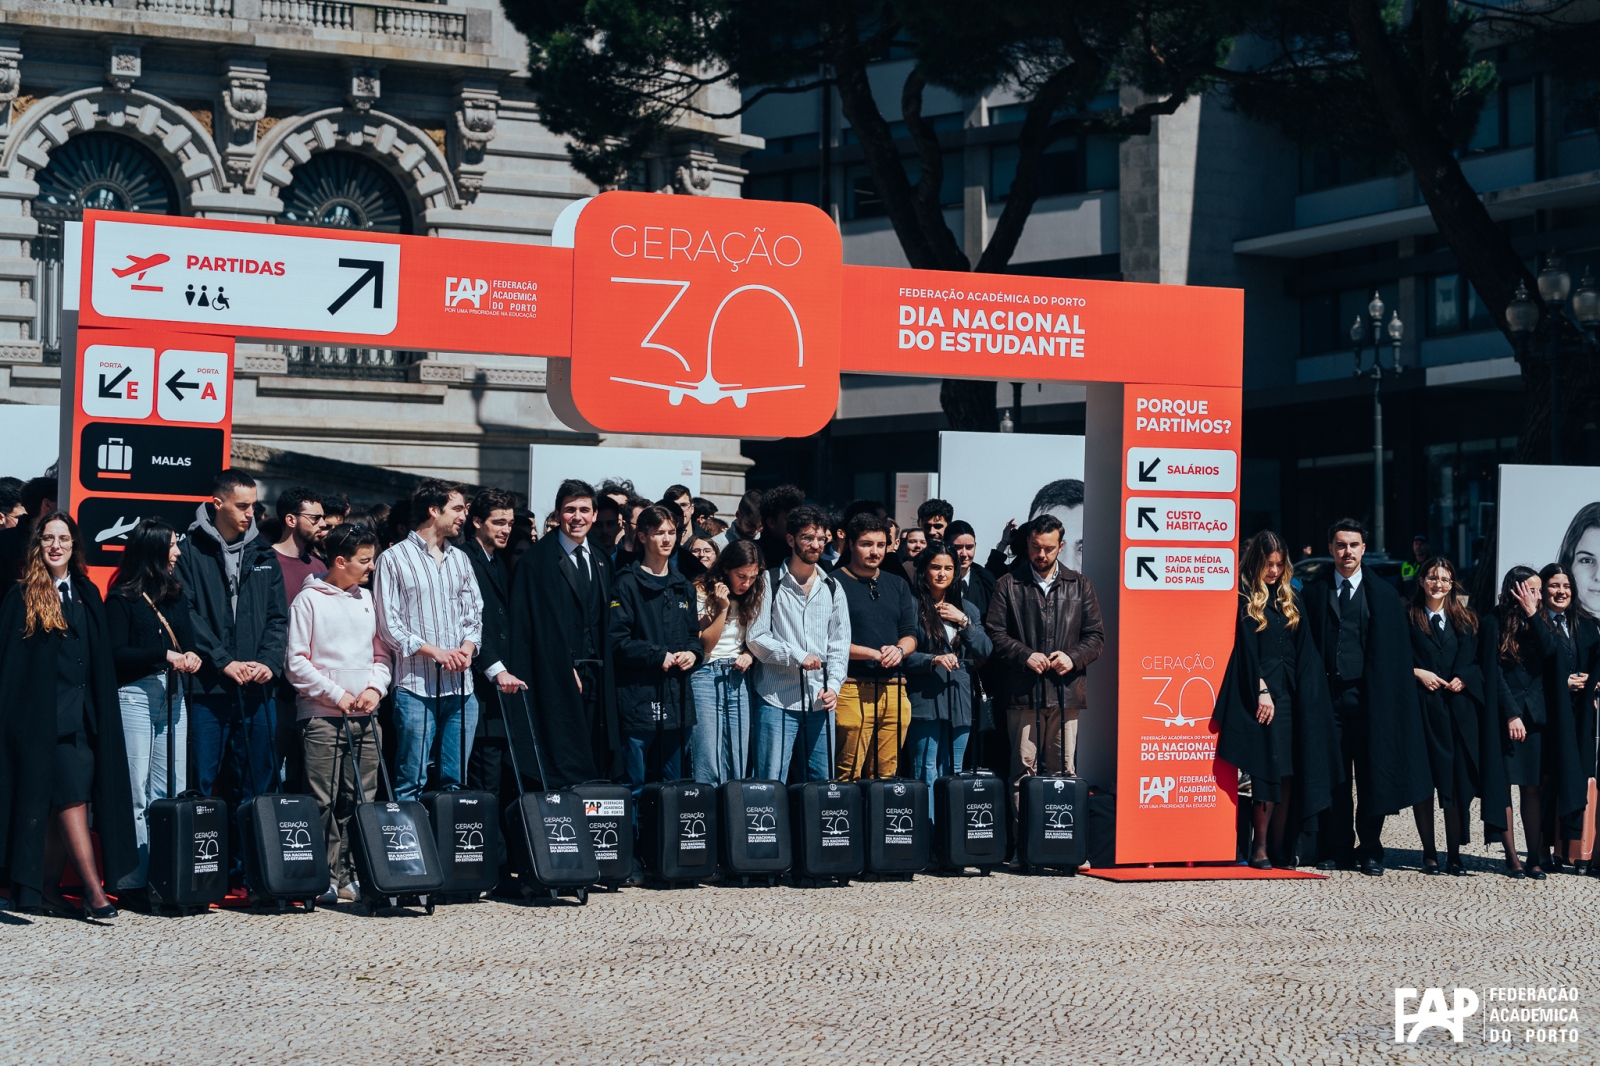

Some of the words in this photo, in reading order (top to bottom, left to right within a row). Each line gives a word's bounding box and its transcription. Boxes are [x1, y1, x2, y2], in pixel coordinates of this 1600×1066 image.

[610, 224, 802, 272] GERAÇÃO
[186, 254, 286, 276] PARTIDAS
[445, 276, 488, 308] FAP
[493, 280, 538, 290] FEDERAÇÃO
[899, 287, 964, 301] FEDERAÇÃO
[967, 291, 1030, 304] ACADÉMICA
[1033, 296, 1048, 305] DO
[1051, 297, 1086, 307] PORTO
[492, 302, 504, 310] DO
[510, 303, 536, 312] PORTO
[899, 305, 944, 328] DIA
[953, 308, 1086, 334] NACIONAL
[898, 328, 934, 351] DO
[940, 331, 1085, 358] ESTUDANTE
[126, 381, 138, 400] E
[200, 382, 217, 400] A
[1136, 398, 1208, 416] PORQUE
[1136, 417, 1232, 434] PARTIMOS?
[152, 456, 192, 467] MALAS
[1167, 463, 1219, 476] SALÁRIOS
[1166, 510, 1202, 520] CUSTO
[1166, 520, 1228, 534] HABITAÇÃO
[1165, 555, 1191, 564] IDADE
[1194, 554, 1222, 564] MÉDIA
[1165, 564, 1192, 574] SAÍDA
[1208, 566, 1230, 574] CASA
[1165, 576, 1183, 584] DOS
[1185, 576, 1204, 584] PAIS
[1141, 654, 1214, 673] GERAÇÃO
[1141, 742, 1160, 751] DIA
[1162, 742, 1216, 751] NACIONAL
[1141, 752, 1156, 761] DO
[1158, 752, 1216, 761] ESTUDANTE
[1179, 774, 1216, 784] FEDERAÇÃO
[1140, 776, 1175, 804] FAP
